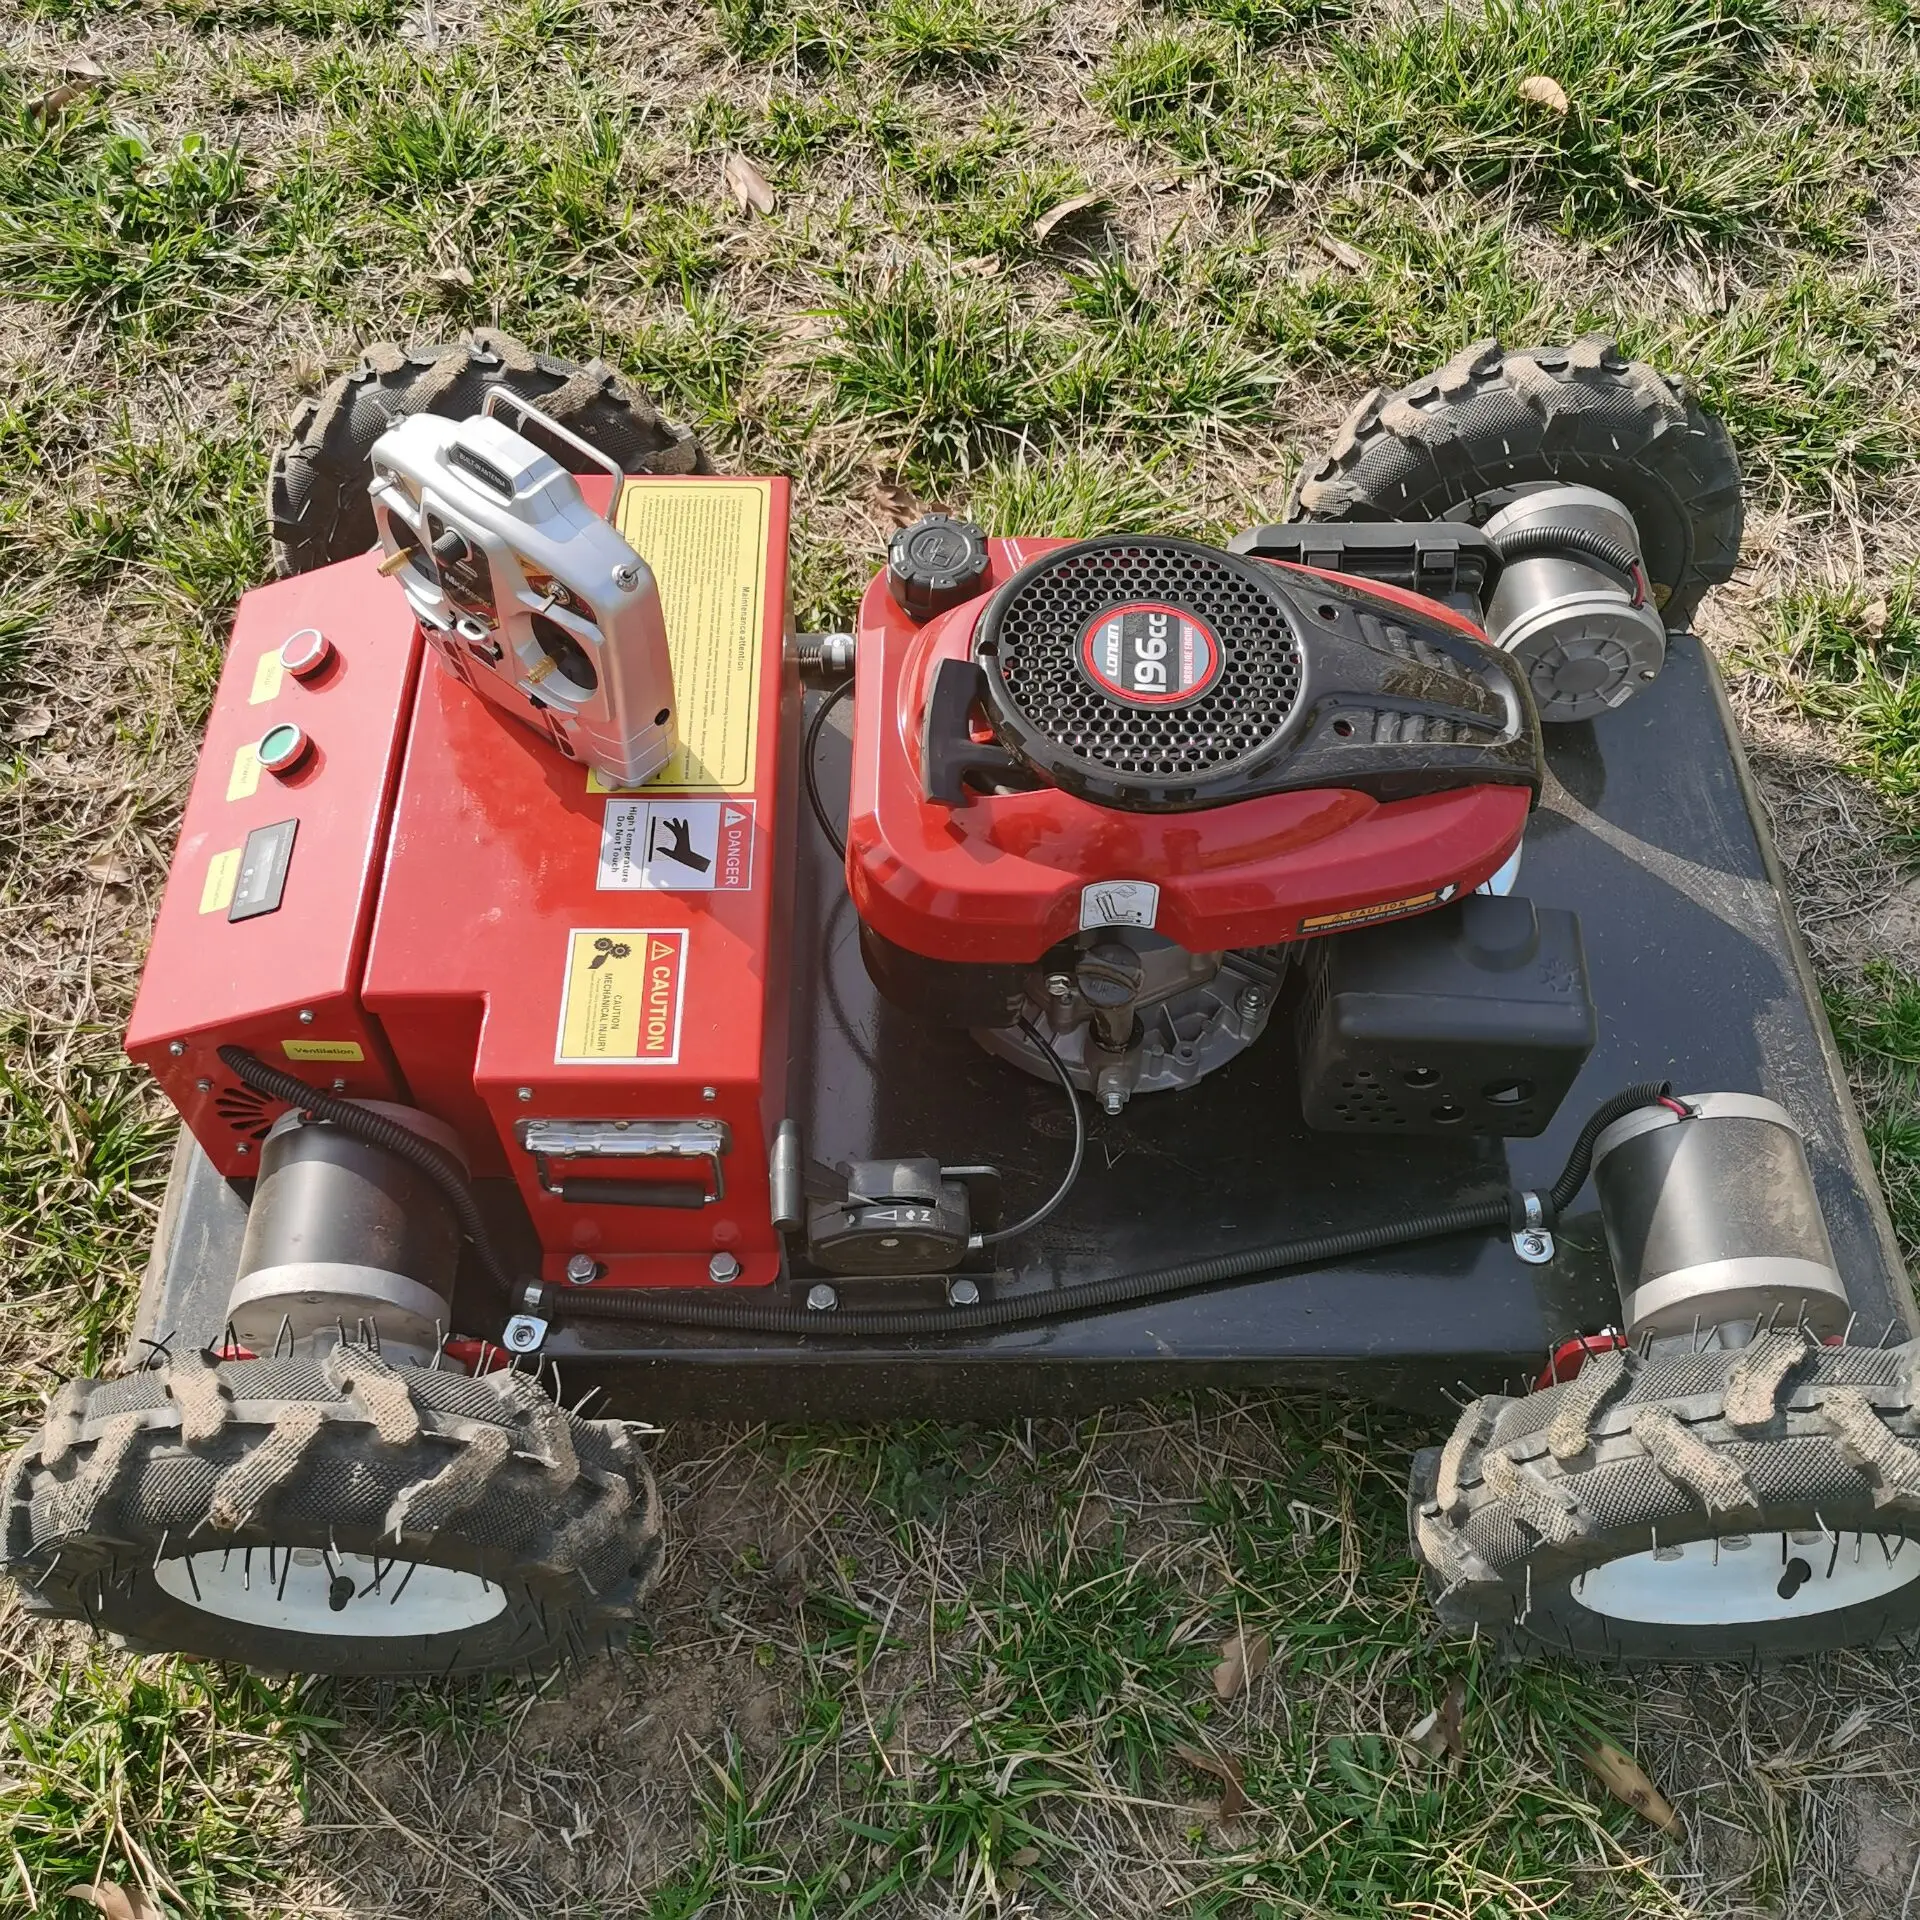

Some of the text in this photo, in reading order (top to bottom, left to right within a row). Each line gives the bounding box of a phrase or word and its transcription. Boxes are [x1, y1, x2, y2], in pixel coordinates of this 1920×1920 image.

[737, 586, 750, 671] Maintenance attention
[1106, 624, 1120, 677] LONCIN
[1133, 613, 1168, 693] 196cc
[1183, 626, 1194, 684] GASOLINE ENGINE
[611, 815, 625, 873] Do Not Touch
[622, 806, 638, 883] High Temperature
[725, 830, 742, 885] DANGER
[1320, 917, 1366, 930] TEMPERATURE
[1349, 900, 1408, 918] CAUTION
[600, 973, 614, 1022] MECHANICAL
[610, 995, 623, 1030] CAUTION
[646, 966, 671, 1051] CAUTION
[293, 1047, 355, 1055] Ventilation
[596, 1024, 607, 1052] INJURY
